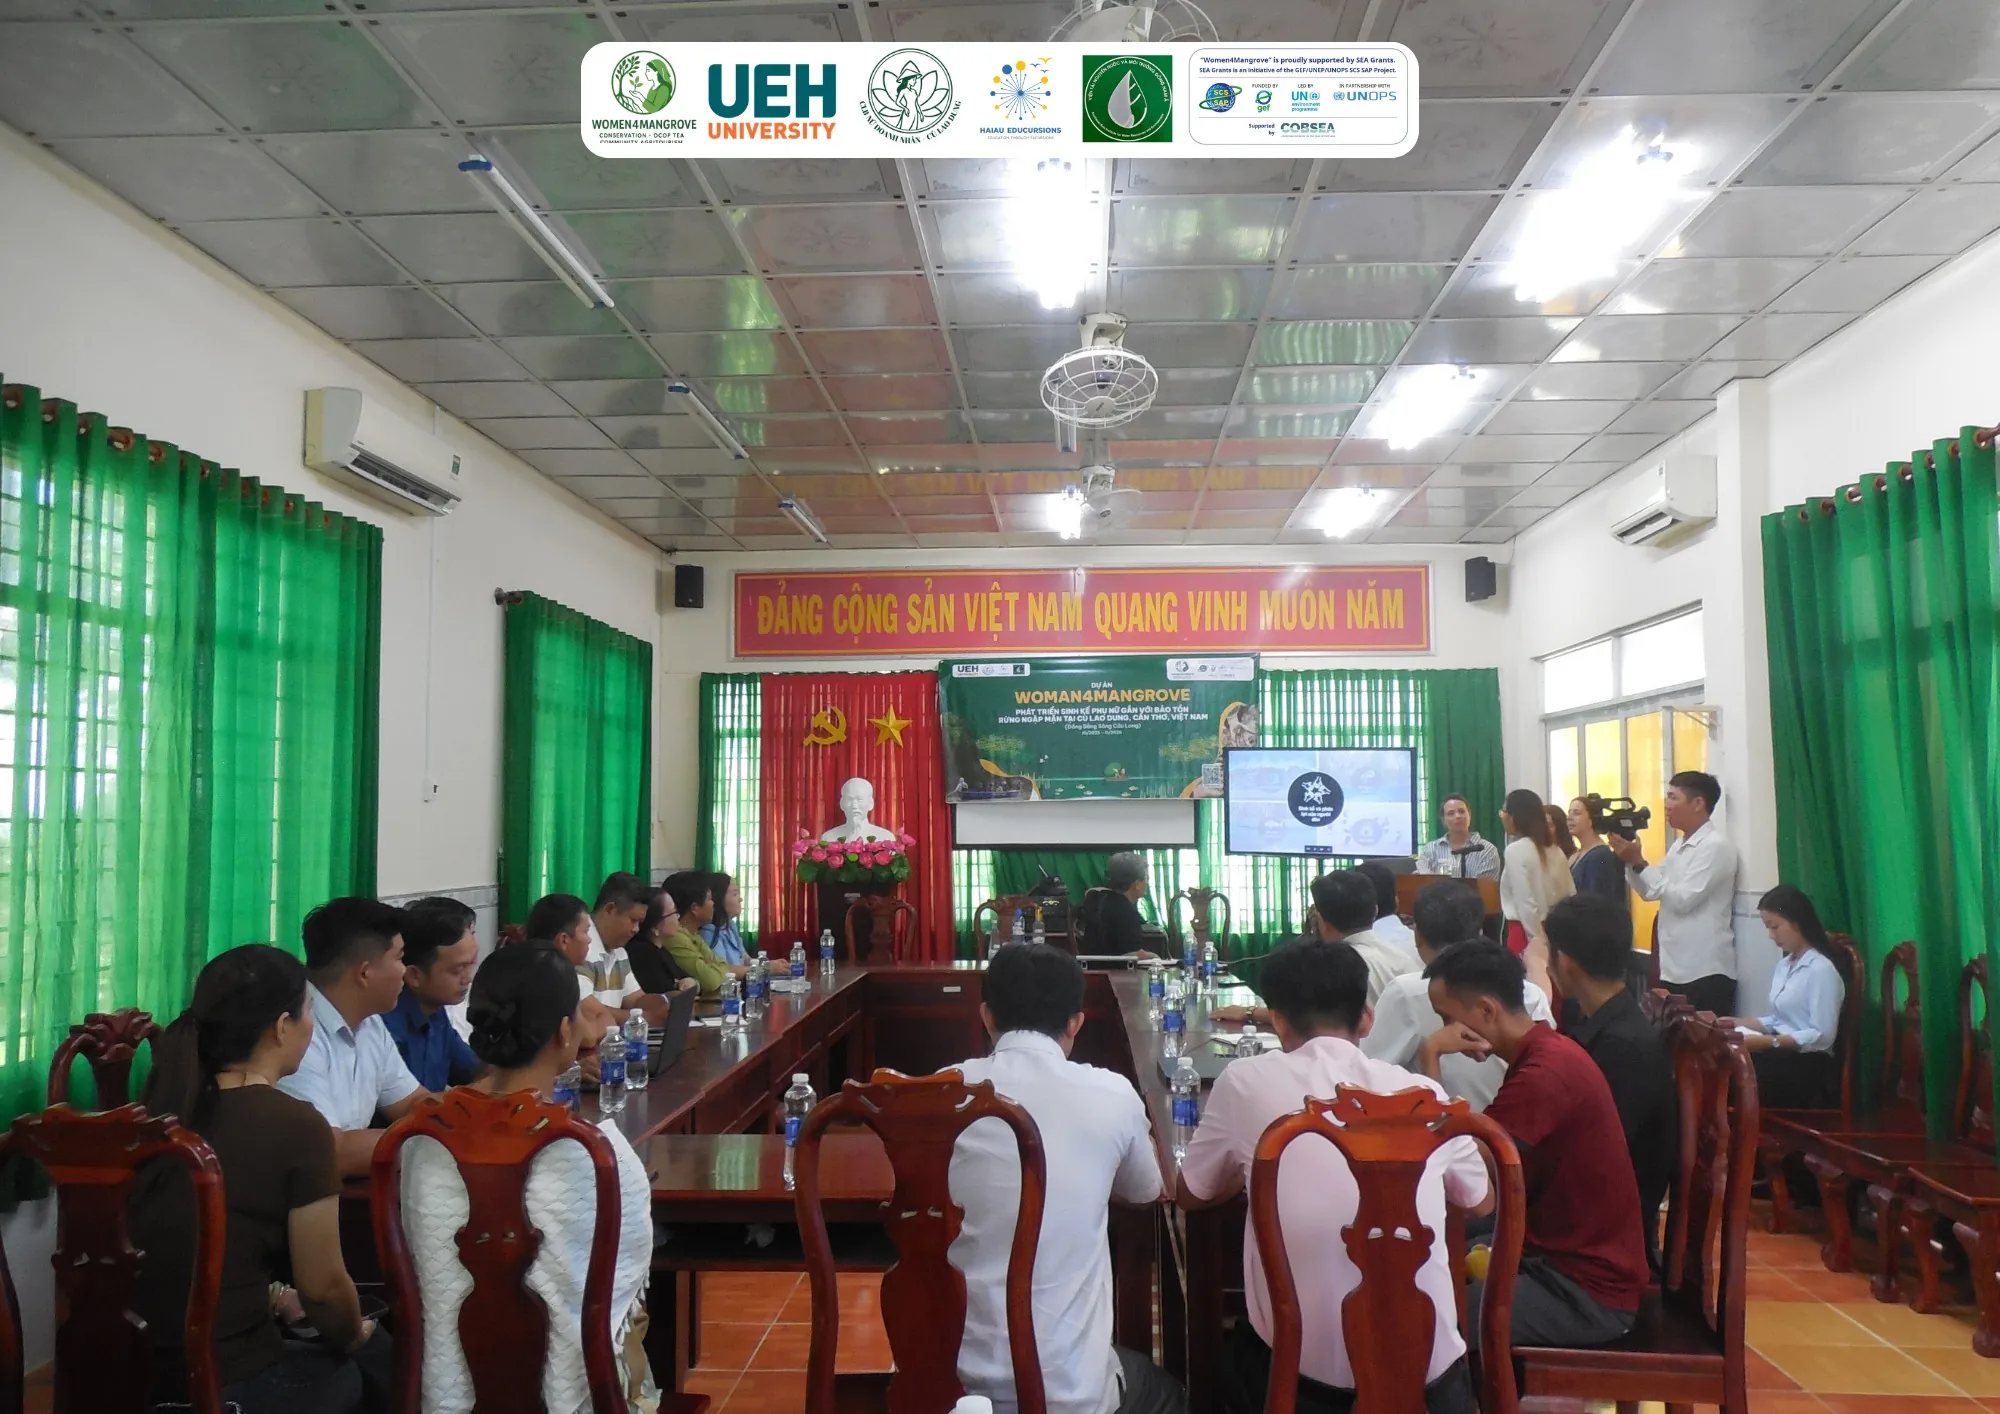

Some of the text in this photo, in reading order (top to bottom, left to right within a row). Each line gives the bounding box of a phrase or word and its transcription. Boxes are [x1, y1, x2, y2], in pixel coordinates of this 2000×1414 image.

[757, 577, 1404, 644] ĐẢNG CỘNG SẢN VIỆT NAM QUANG VINH MUÔN NĂM
[957, 665, 979, 673] UEH
[1014, 688, 1191, 704] WOMAN4MANGROVE
[1015, 708, 1036, 716] PHÁT
[1037, 705, 1060, 716] TRIỂN
[1080, 705, 1090, 716] KẾ
[1091, 707, 1108, 716] PHỤ
[1108, 705, 1121, 714] NỮ
[1139, 705, 1153, 715] VỚI
[998, 715, 1020, 724] RỪNG
[1022, 715, 1044, 725] NGẬP
[1044, 714, 1062, 724] MẶN
[1064, 715, 1076, 724] TẠI
[1076, 714, 1088, 722] CÙ
[1132, 712, 1150, 722] CẦN
[1170, 712, 1188, 722] VIỆT
[1190, 713, 1208, 721] NAM
[1124, 722, 1142, 730] Long)
